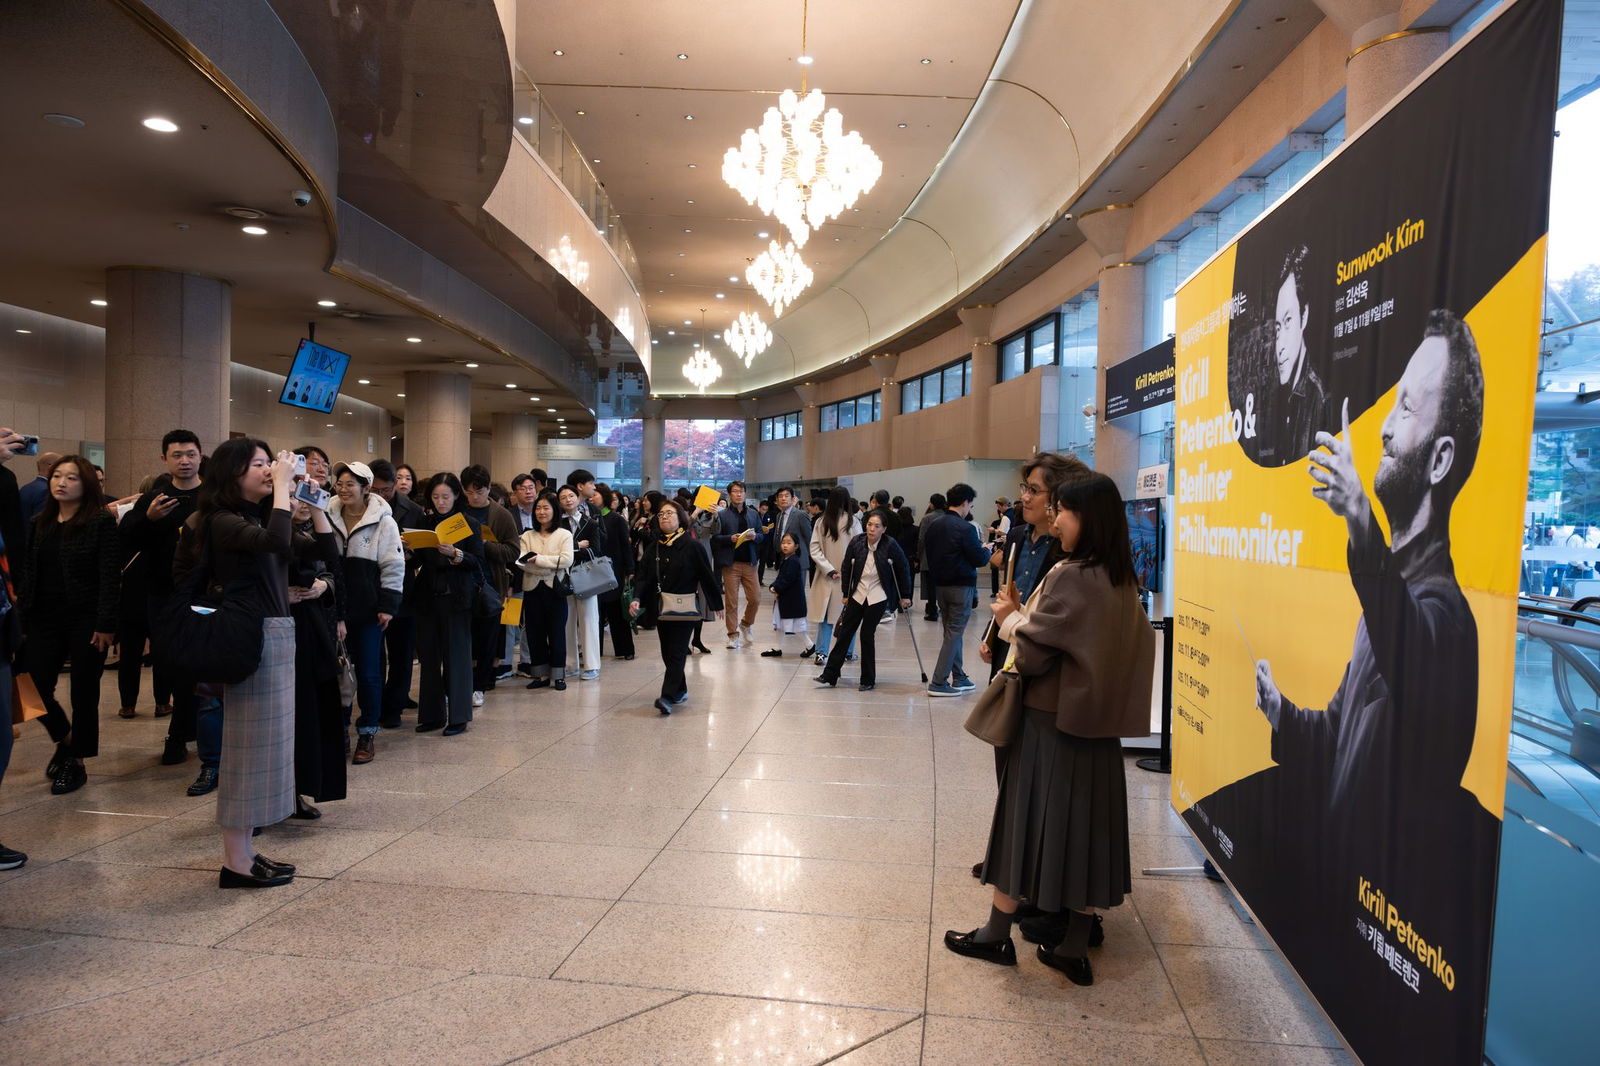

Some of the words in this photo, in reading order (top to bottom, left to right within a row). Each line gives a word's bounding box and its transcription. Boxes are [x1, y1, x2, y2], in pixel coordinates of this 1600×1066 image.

[1336, 231, 1394, 285] Sunwook
[1395, 218, 1425, 253] Kim
[1345, 280, 1369, 308] 김선욱
[1344, 316, 1354, 334] 7일
[1135, 372, 1148, 391] Kirill
[1147, 364, 1175, 386] Petrenko
[1180, 356, 1209, 408] Kirill
[1179, 400, 1243, 456] Petrenko
[1243, 392, 1257, 439] &
[1179, 461, 1232, 504] Berliner
[1178, 511, 1303, 568] Philharmoniker
[1358, 875, 1386, 925] Kirill
[1386, 903, 1455, 991] Petrenko
[1384, 941, 1420, 994] 페트렌코
